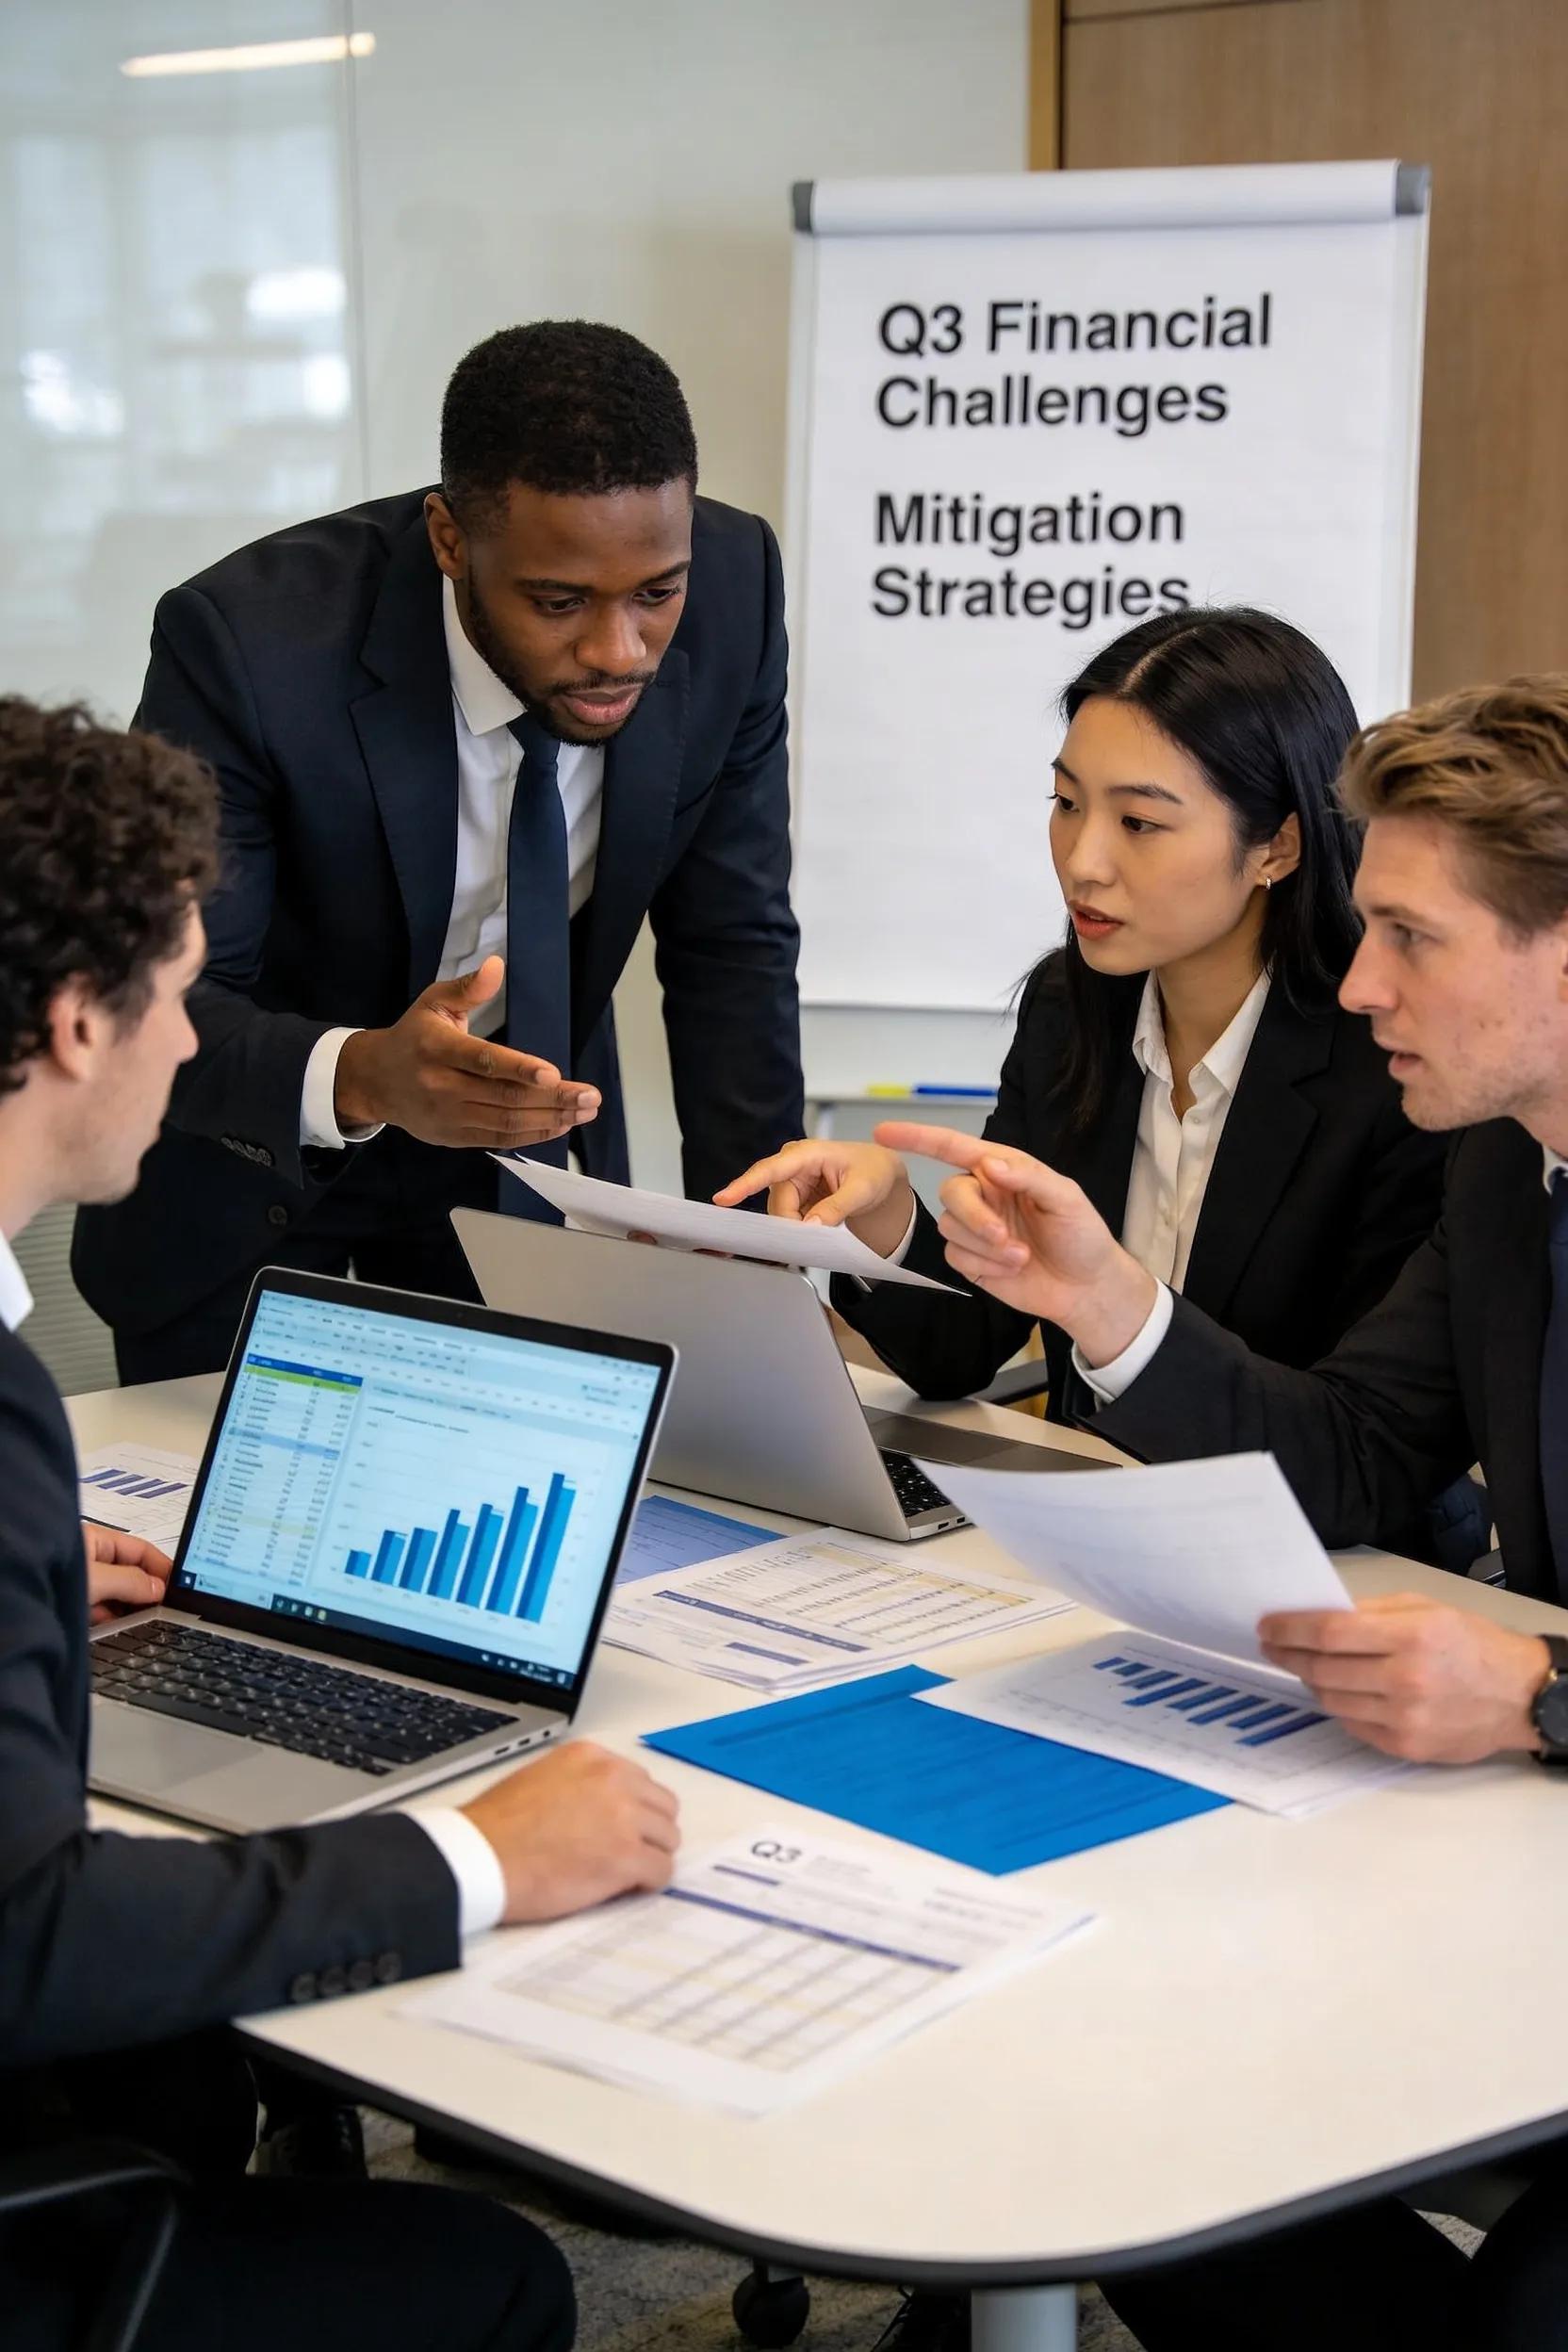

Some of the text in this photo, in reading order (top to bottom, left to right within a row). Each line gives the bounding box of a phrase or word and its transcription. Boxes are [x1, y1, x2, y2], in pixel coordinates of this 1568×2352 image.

[877, 291, 1272, 359] Q3 Financial
[875, 373, 1230, 439] Challenges
[875, 491, 1184, 559] Mitigation
[872, 564, 1190, 631] Strategies
[750, 1839, 803, 1865] Q3
